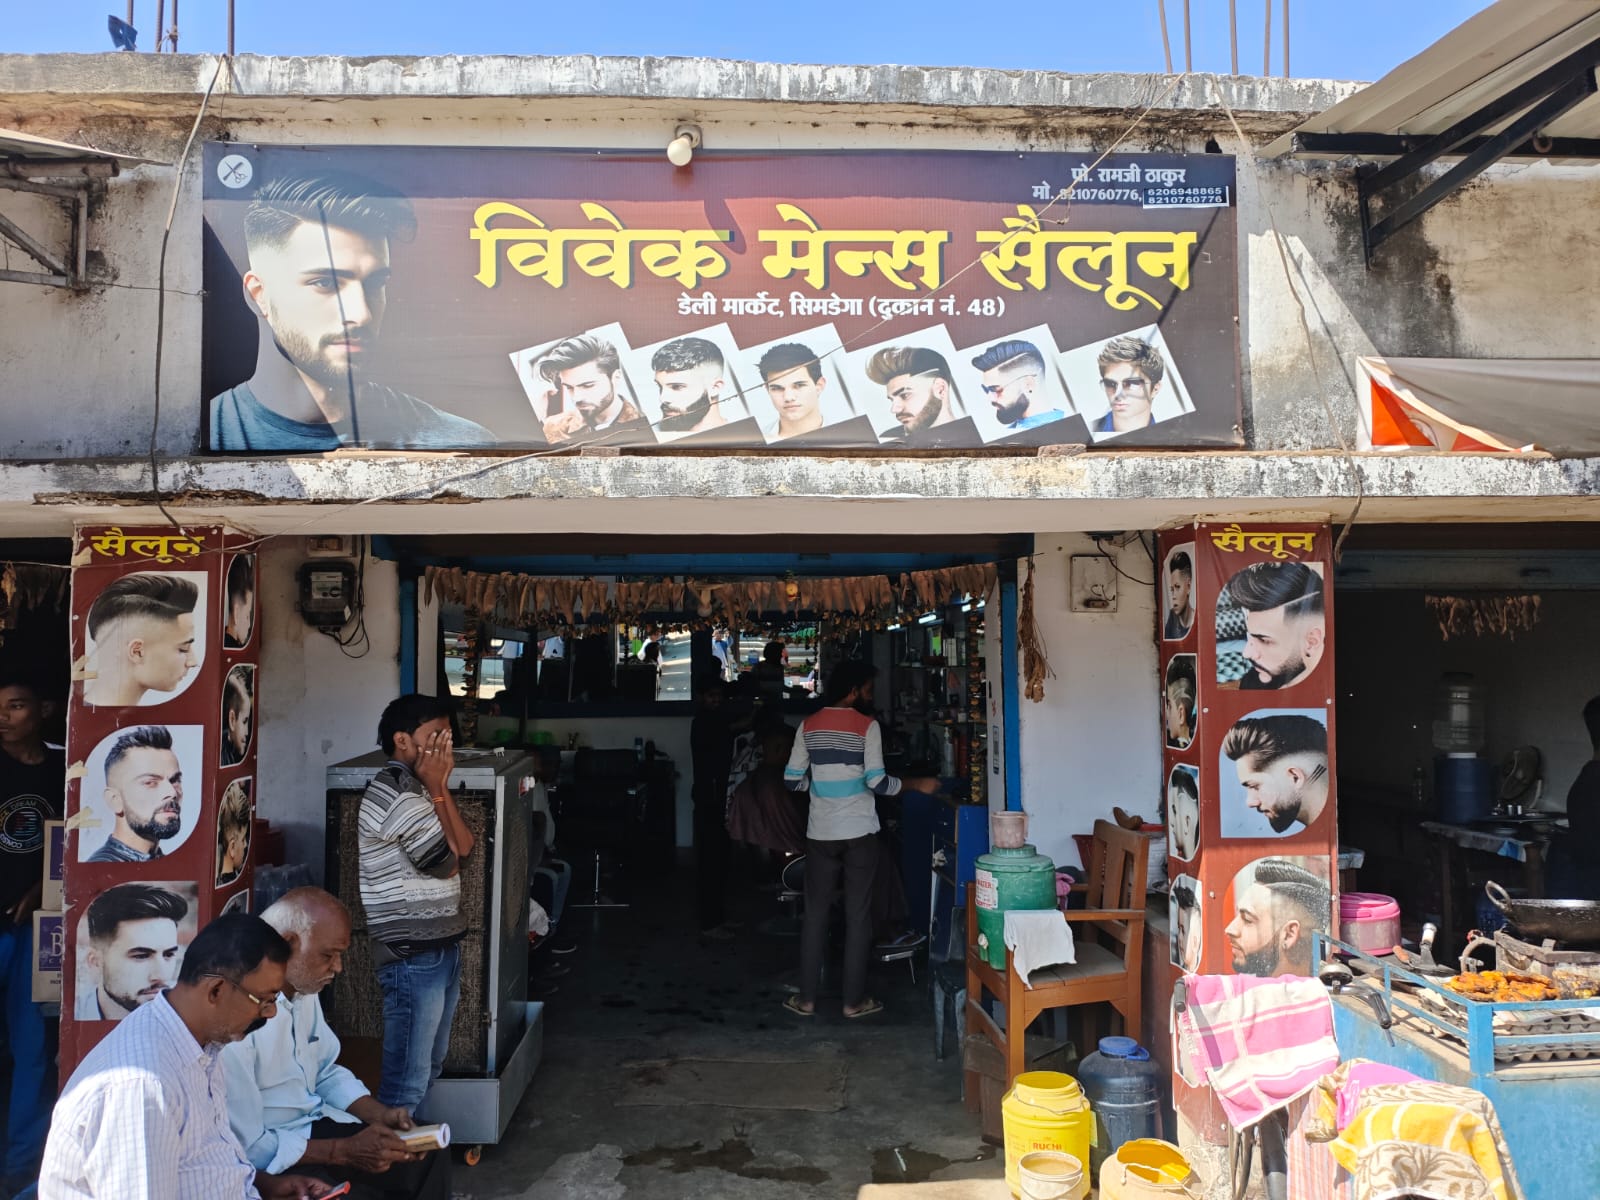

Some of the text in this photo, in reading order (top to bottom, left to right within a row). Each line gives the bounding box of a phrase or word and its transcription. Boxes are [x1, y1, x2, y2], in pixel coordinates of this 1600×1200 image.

[1097, 163, 1142, 183] रामजी
[1145, 167, 1187, 188] ठाकुर
[1032, 180, 1054, 200] मो.
[469, 201, 1198, 311] विवेक मेन्स सैलून
[677, 291, 718, 316] डेली
[722, 291, 785, 318] मार्केट,
[789, 292, 863, 316] सिमडेगा
[940, 297, 961, 317] नं.
[967, 298, 1006, 318] 48)
[91, 526, 206, 564] सैलून
[1210, 523, 1317, 559] सैलून
[1032, 1142, 1062, 1151] RUCHI
